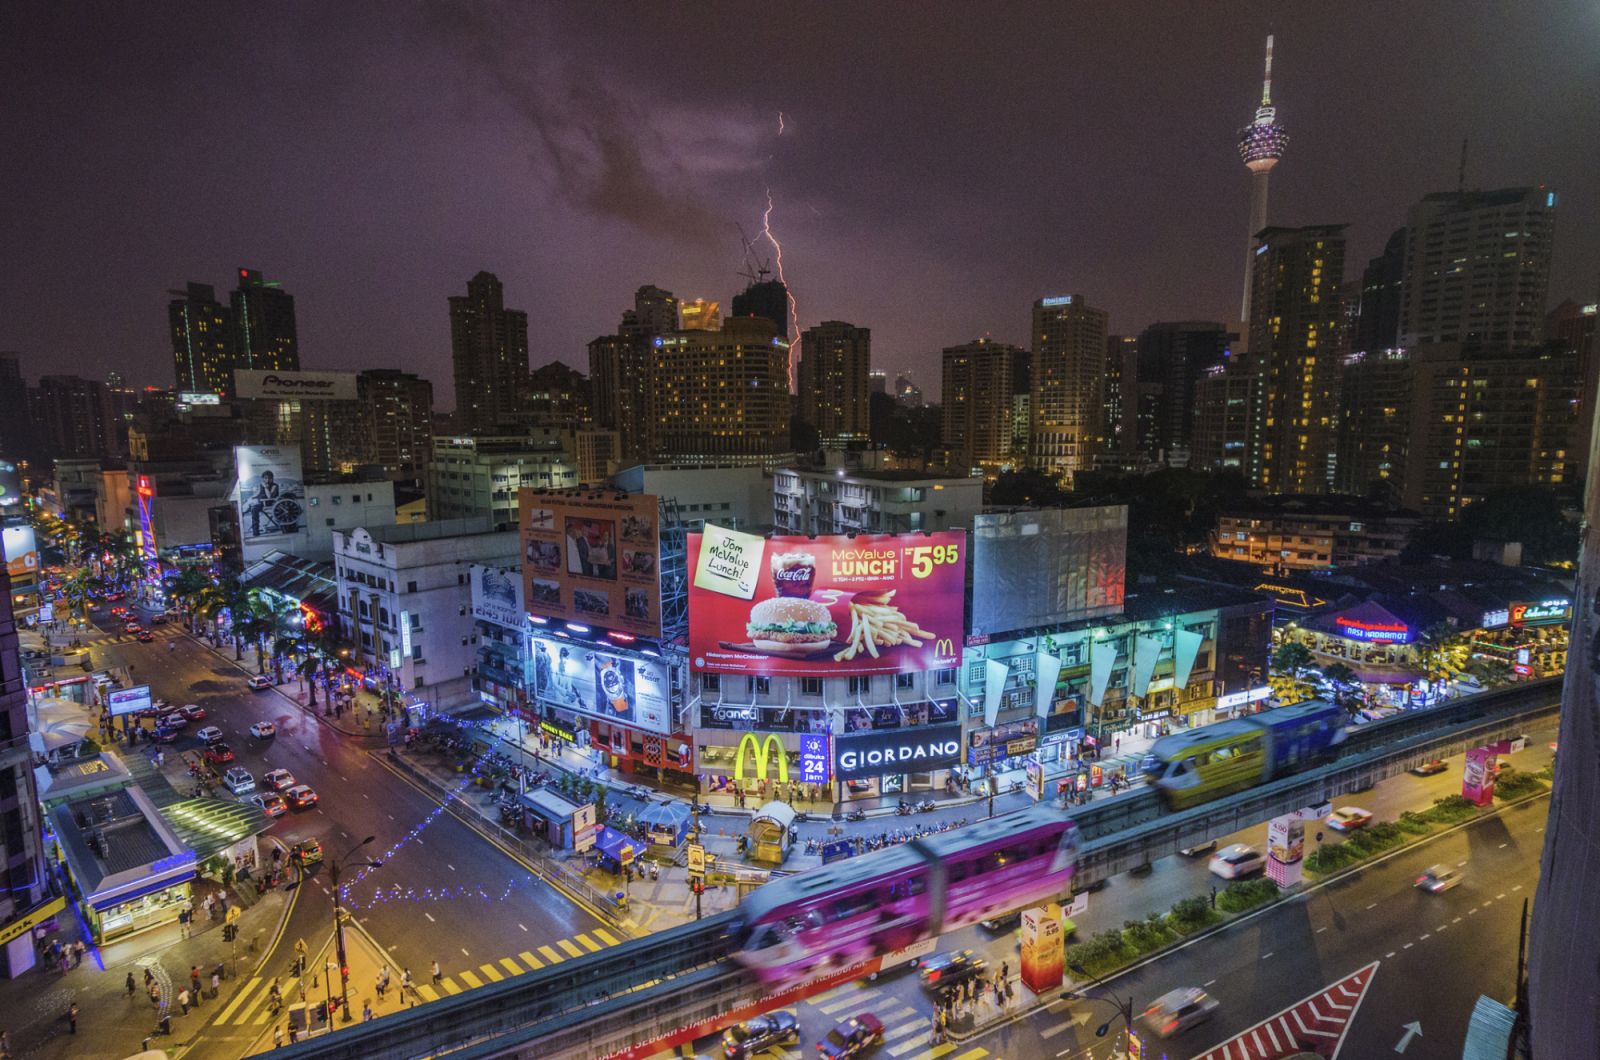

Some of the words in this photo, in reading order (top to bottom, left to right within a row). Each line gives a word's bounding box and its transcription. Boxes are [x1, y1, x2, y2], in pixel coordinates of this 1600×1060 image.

[262, 375, 335, 388] Pioneer
[722, 537, 743, 554] Jom
[709, 546, 749, 568] McValue
[832, 549, 896, 560] McValue
[708, 558, 744, 579] Lunch!
[832, 560, 895, 576] LUNCH
[840, 741, 959, 768] GIORDANO
[804, 760, 825, 773] 24
